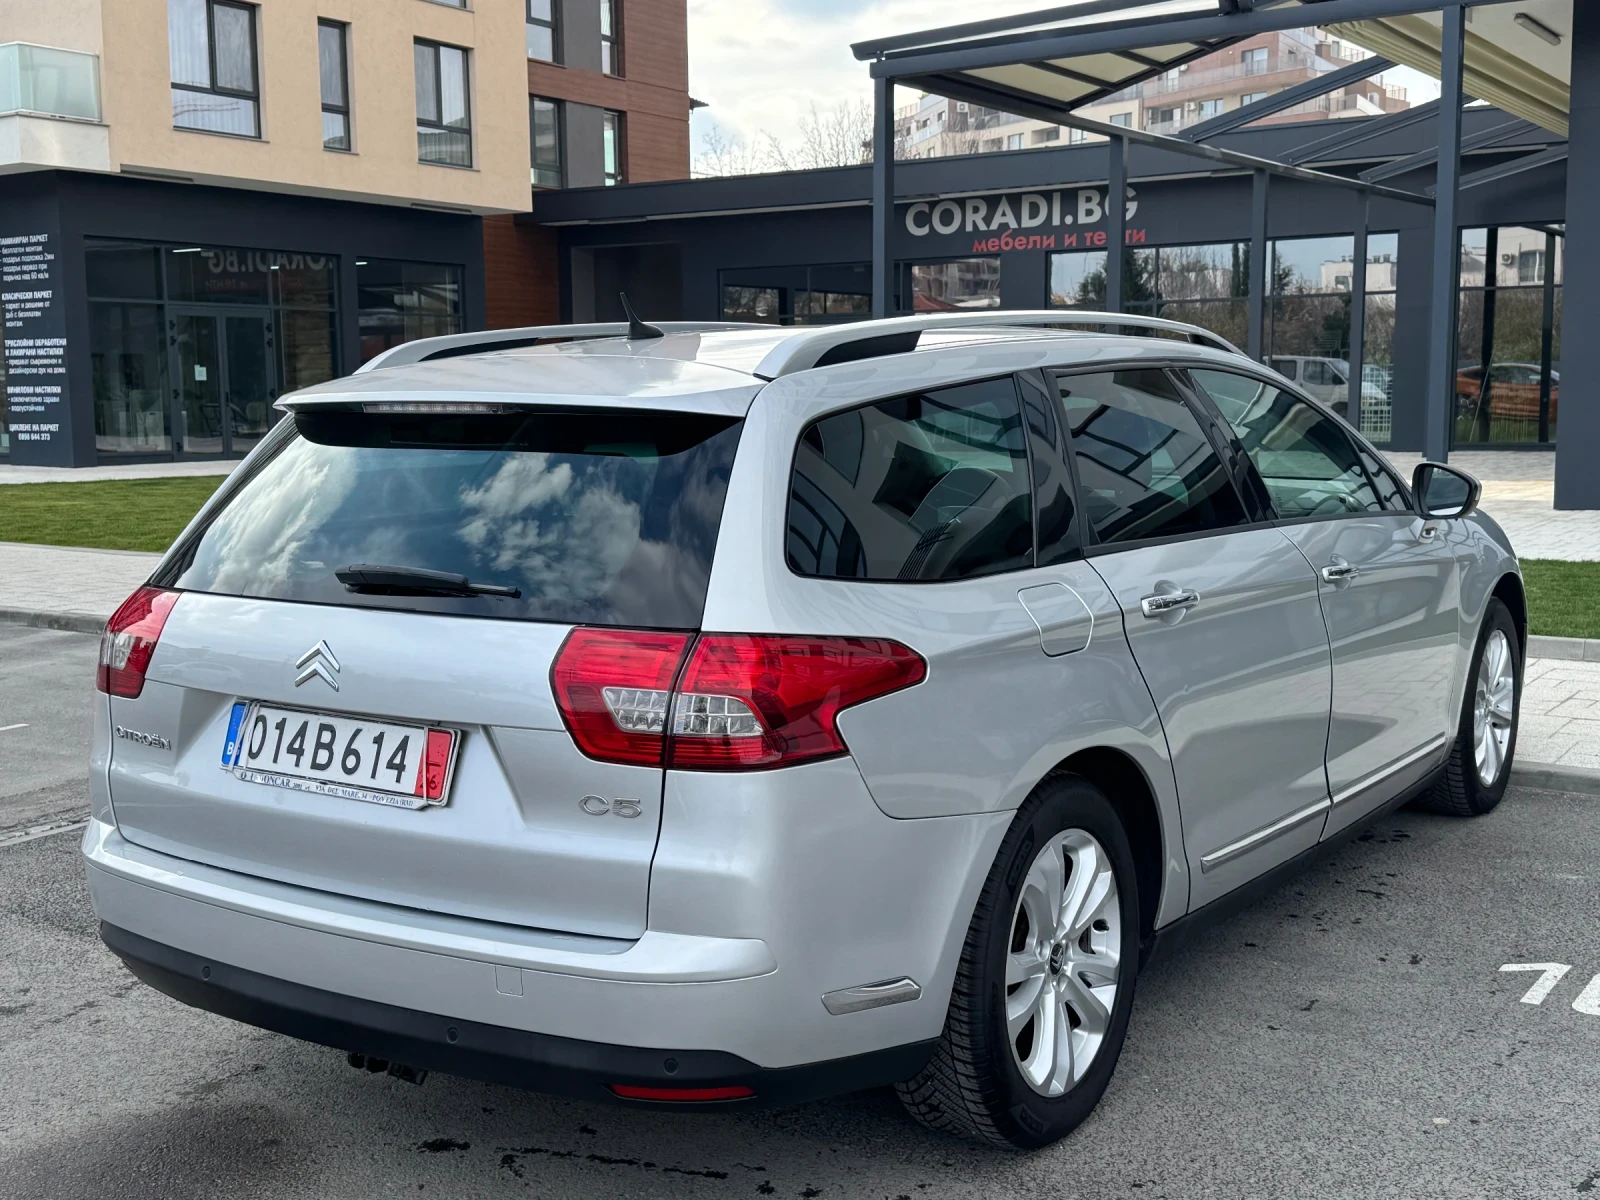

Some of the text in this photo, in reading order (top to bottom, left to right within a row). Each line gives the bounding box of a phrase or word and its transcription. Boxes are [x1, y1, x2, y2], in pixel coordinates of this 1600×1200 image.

[29, 235, 48, 243] ПАРКЕТ
[972, 228, 1146, 252] мебели и тети
[30, 272, 38, 280] 60
[2, 291, 52, 301] КЛАСИЧЕСКИ ПАРКЕТ
[4, 339, 67, 348] ТРИСЛОЙНИ ОБРАБОТЕНИ
[36, 348, 64, 356] НАСТИЛКИ
[7, 386, 61, 394] ВИНИЛОВИ НАСТИЛКИ
[40, 424, 59, 432] ПАРКЕТ
[115, 725, 172, 751] CITROËN
[247, 714, 410, 784] 014B614
[578, 794, 642, 819] C5
